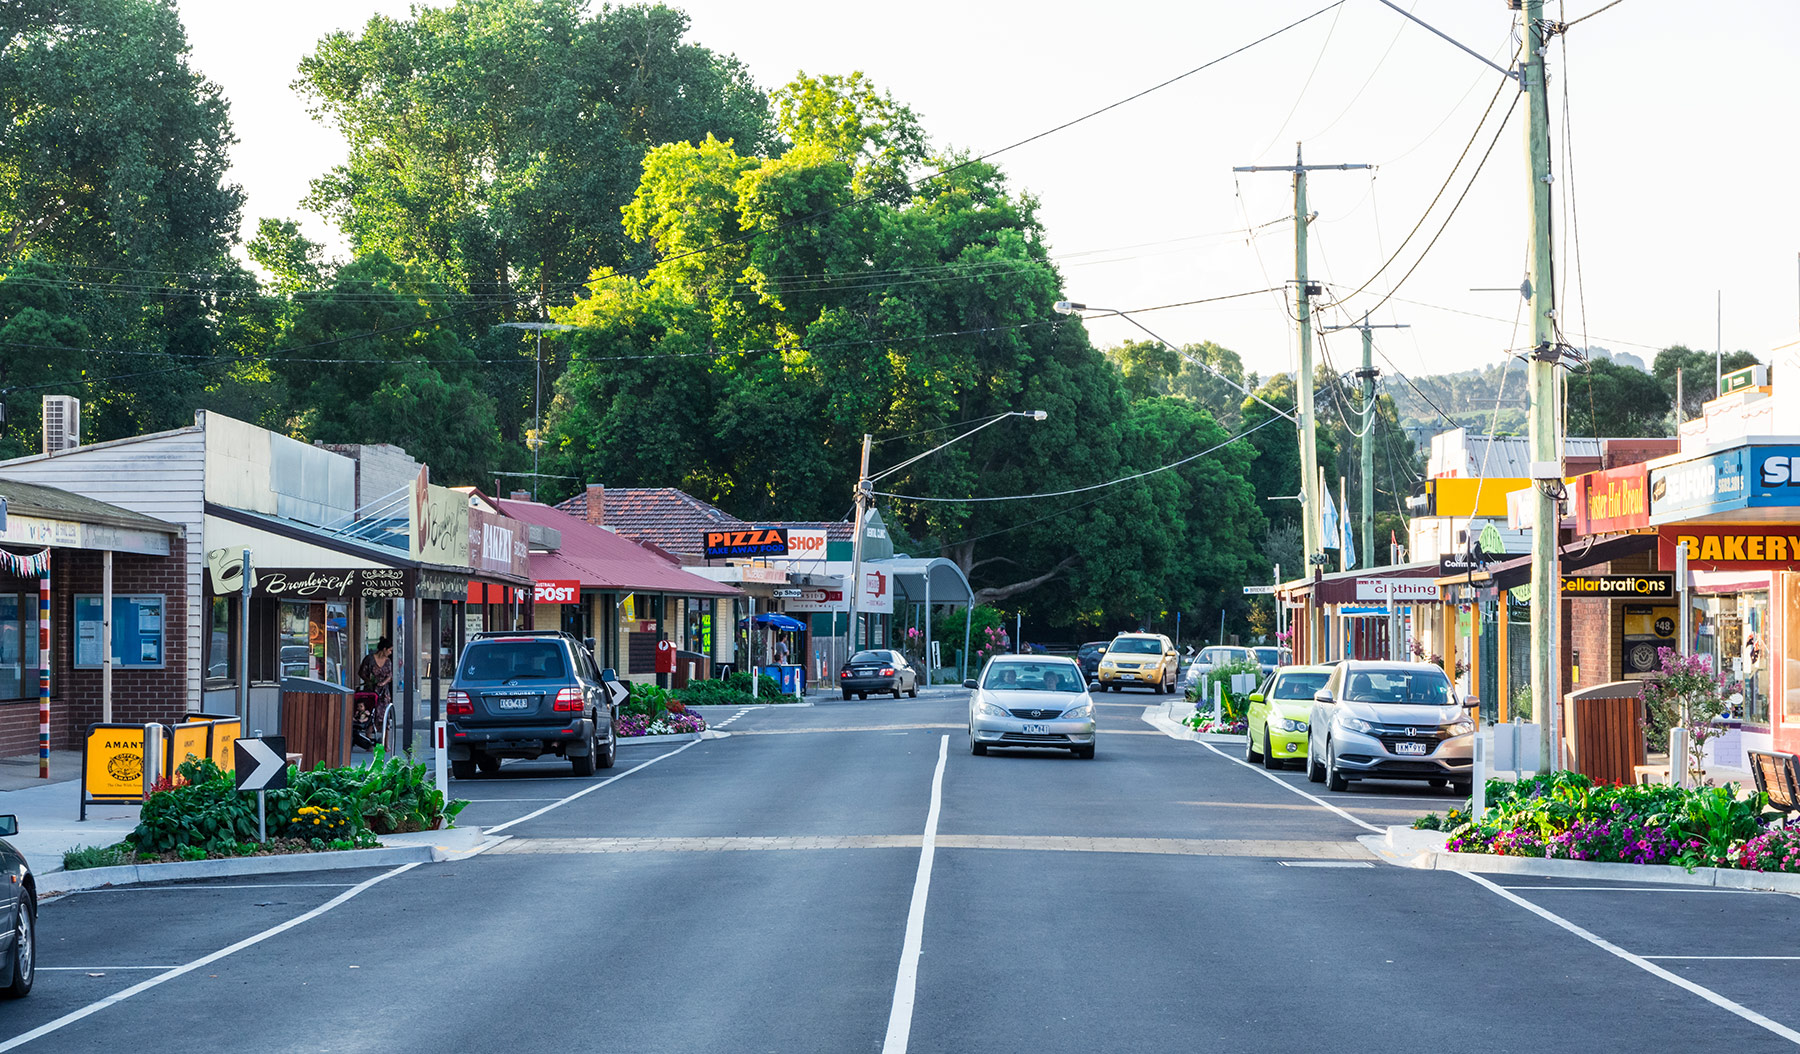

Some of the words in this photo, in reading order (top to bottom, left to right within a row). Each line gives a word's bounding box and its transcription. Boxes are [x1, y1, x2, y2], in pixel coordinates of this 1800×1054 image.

[1763, 456, 1800, 484] S
[1667, 465, 1716, 504] SEAFOOD
[1587, 486, 1607, 520] Foster
[1608, 482, 1621, 518] Hot
[1622, 475, 1643, 516] Bread
[482, 523, 514, 563] BAKERY
[708, 530, 784, 547] PIZZA
[788, 537, 824, 551] SHOP
[707, 547, 730, 555] TAKE
[732, 545, 758, 554] AWAY
[760, 544, 785, 553] FOOD
[1677, 535, 1800, 561] BAKERY
[260, 572, 329, 596] Bromley's
[327, 570, 354, 596] Café
[1560, 578, 1666, 594] Cellarbrations
[535, 587, 575, 601] POST
[784, 589, 801, 597] Shop
[105, 741, 143, 749] AMANT
